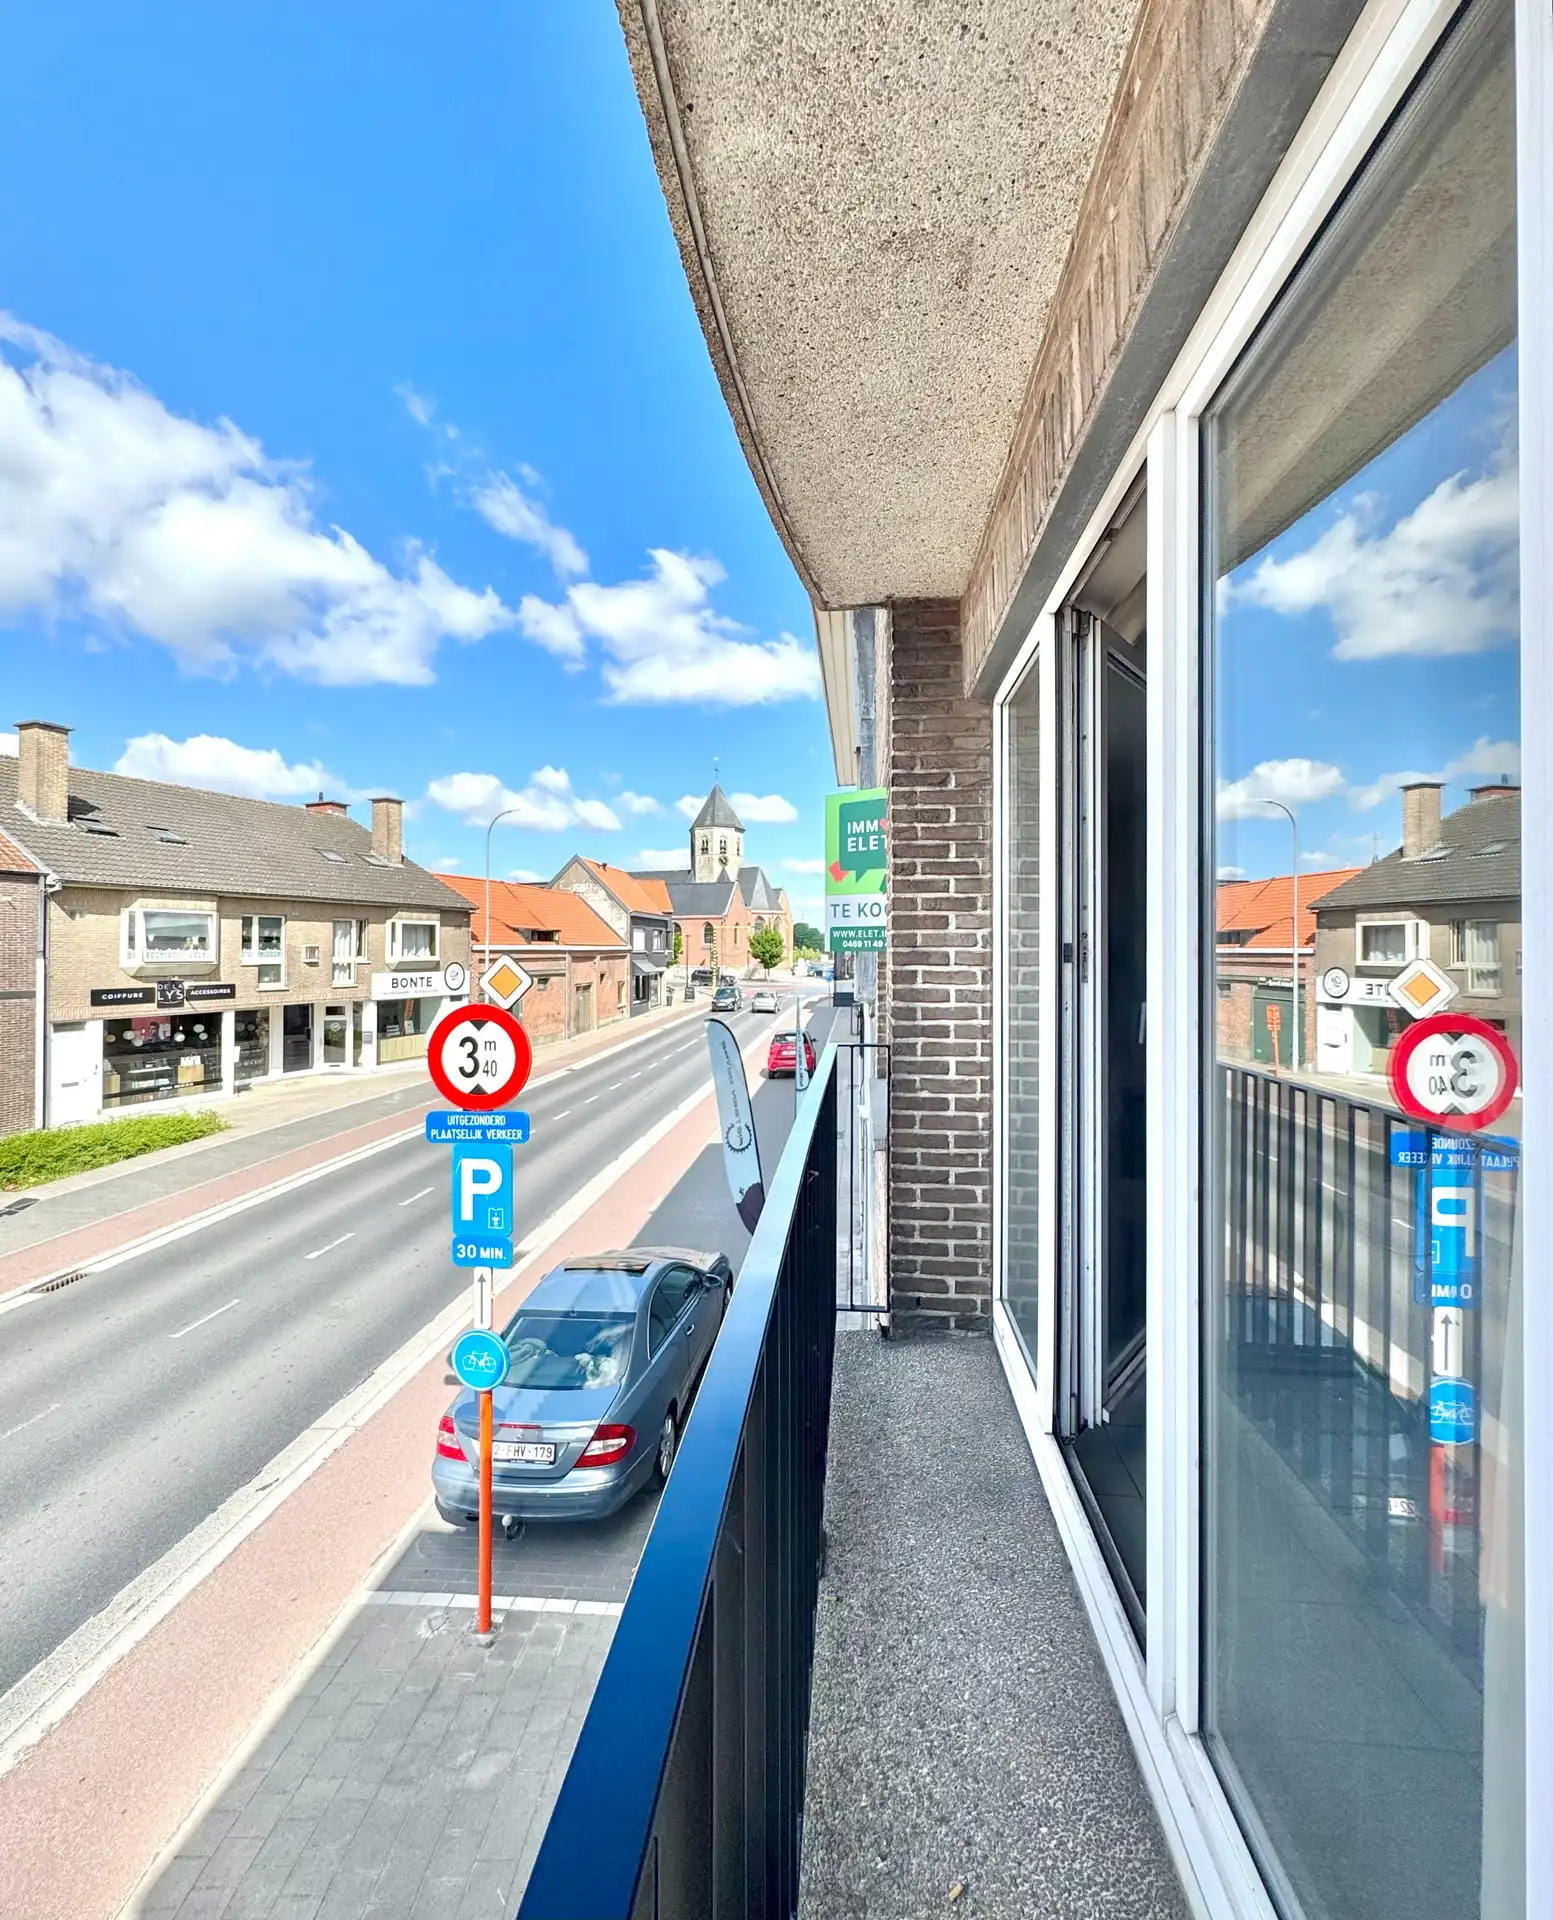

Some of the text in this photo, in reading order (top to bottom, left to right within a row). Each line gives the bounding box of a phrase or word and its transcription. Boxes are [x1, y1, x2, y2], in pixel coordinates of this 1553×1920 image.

[830, 902, 888, 918] TE KO
[391, 977, 432, 988] BONTE
[101, 992, 143, 1000] COIFFURE
[157, 990, 184, 1000] LYS
[190, 988, 231, 996] ACCESSOIRES
[458, 1036, 497, 1079] 3 m
[482, 1059, 498, 1077] 40
[447, 1114, 506, 1126] UITGEZONDERD
[430, 1128, 523, 1140] PLAATSELIJK VERKEER
[460, 1157, 503, 1221] P
[456, 1244, 507, 1260] 30 MIN.
